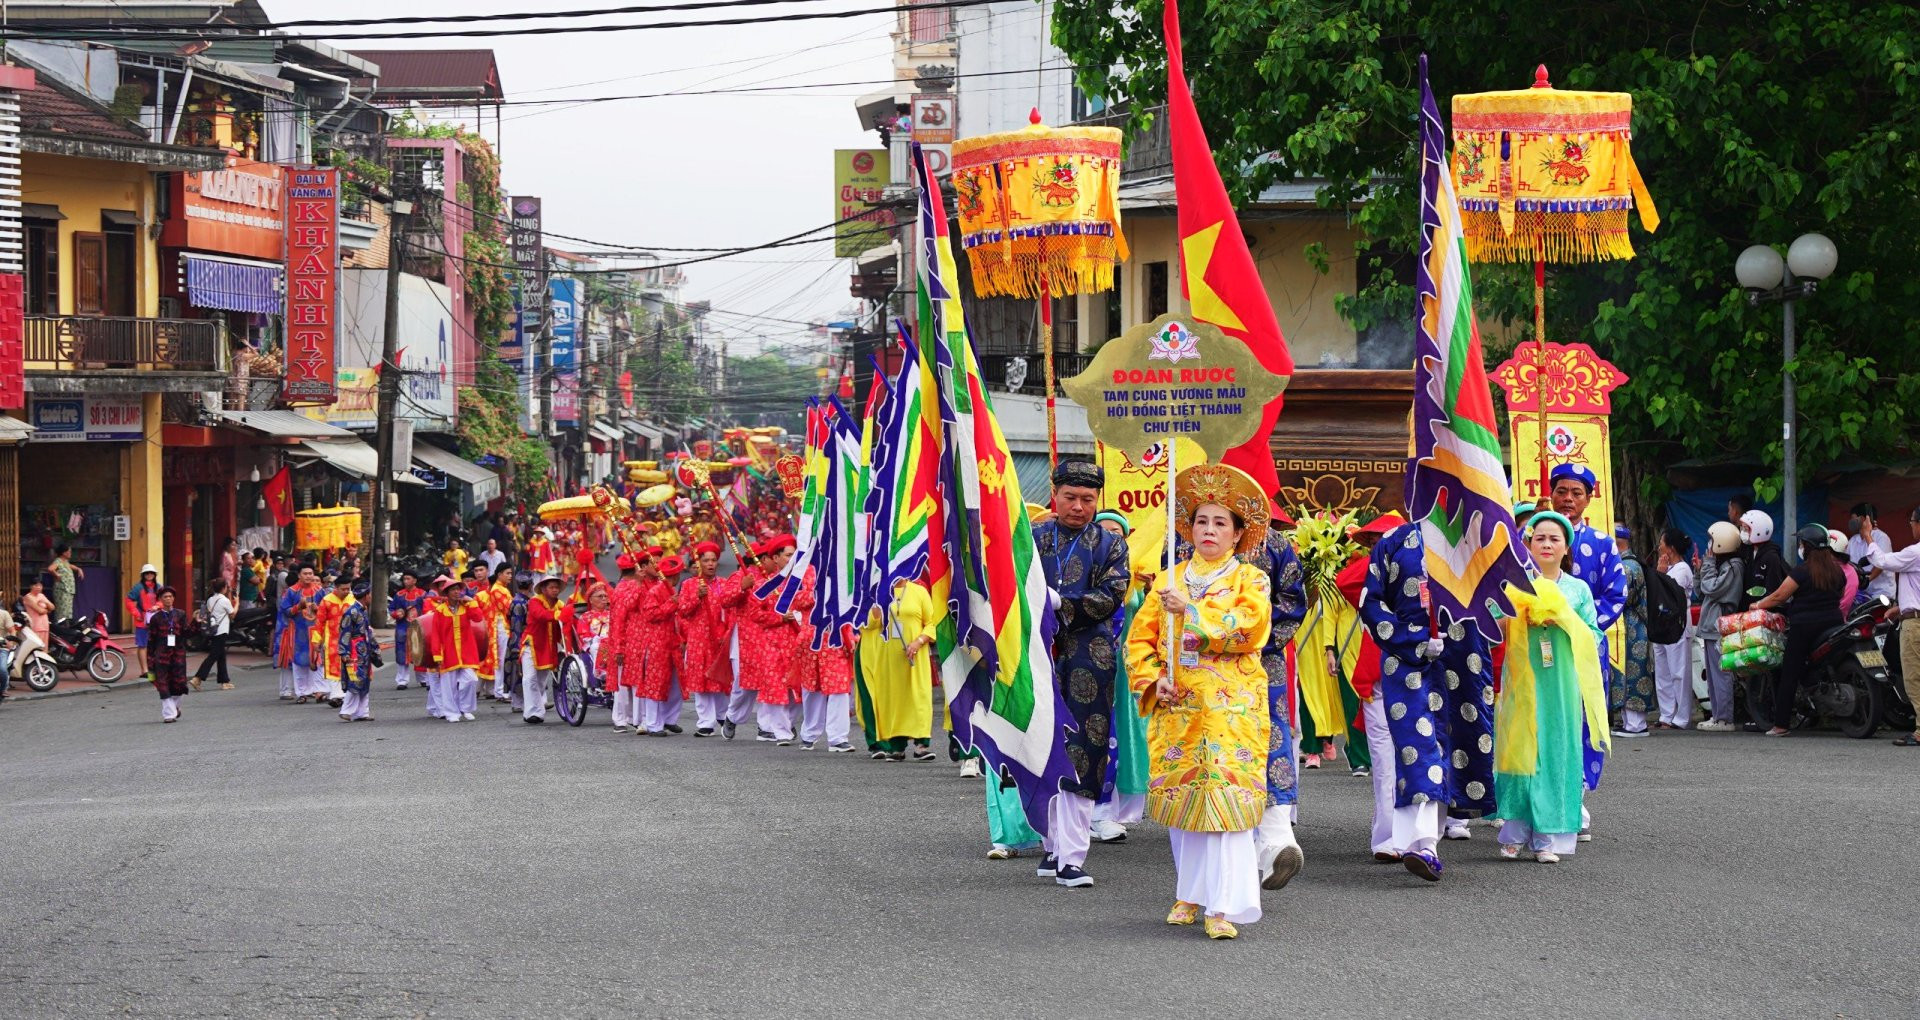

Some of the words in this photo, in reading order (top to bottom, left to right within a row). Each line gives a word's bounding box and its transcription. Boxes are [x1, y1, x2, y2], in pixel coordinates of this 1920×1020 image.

[513, 218, 538, 230] CUNG
[1112, 366, 1173, 384] ĐOÀN
[1180, 365, 1237, 384] RƯỚC
[1103, 390, 1129, 402] TAM
[1132, 389, 1167, 401] CUNG
[1170, 387, 1213, 400] VƯƠNG
[1107, 403, 1129, 419] HỘI
[1171, 402, 1196, 418] LIỆT
[1143, 420, 1170, 433] CHƯ
[1172, 419, 1201, 433] TIÊN
